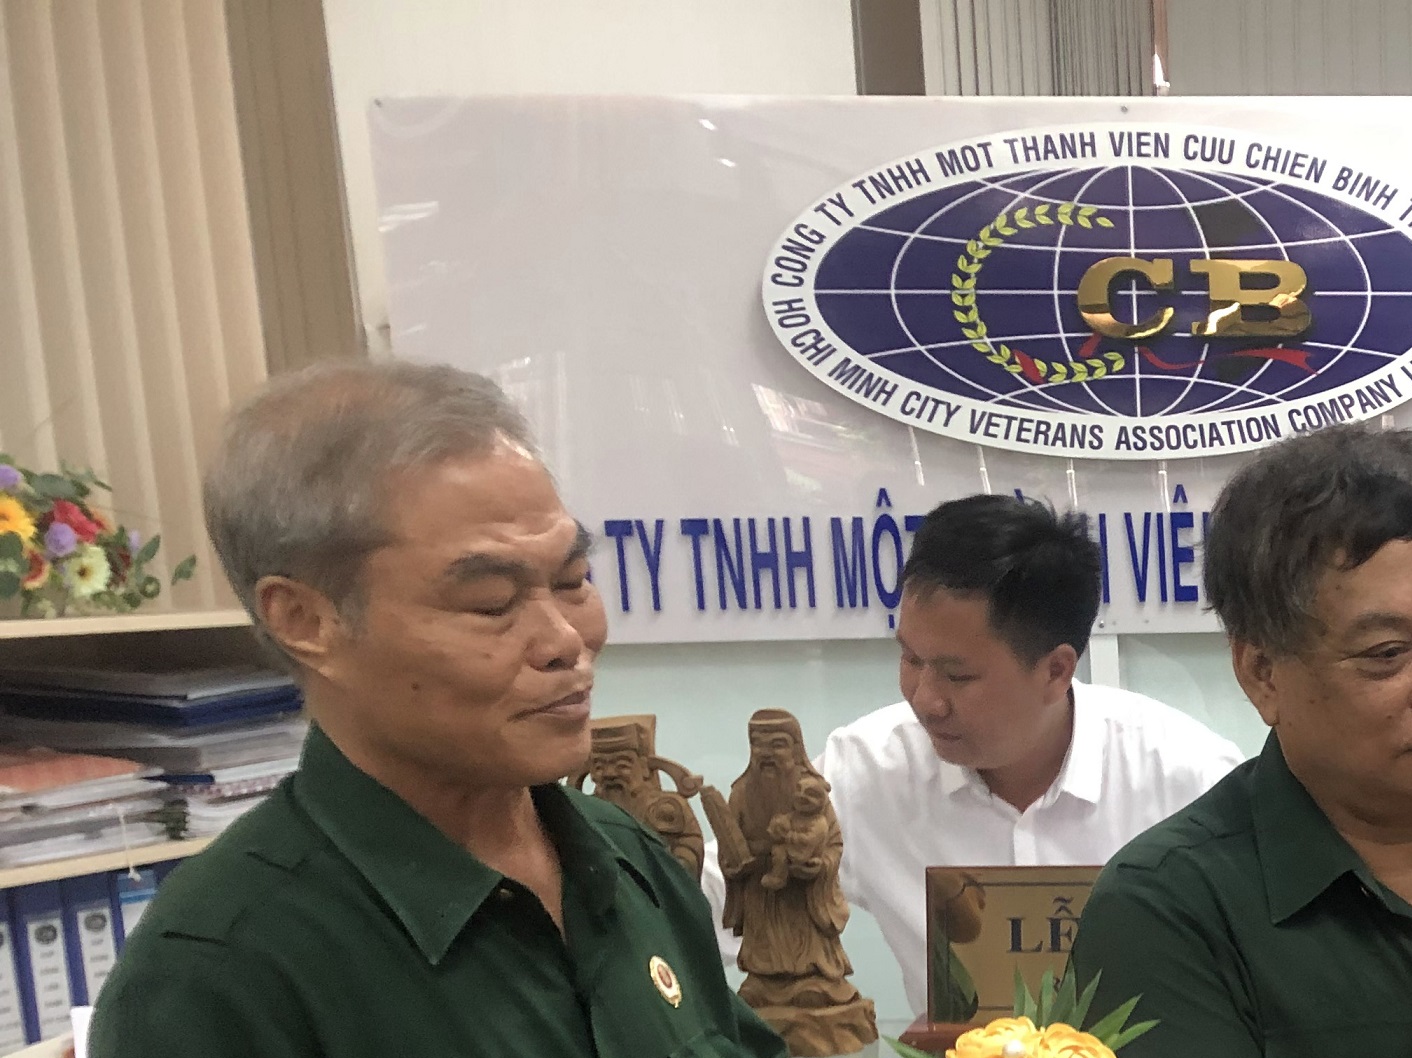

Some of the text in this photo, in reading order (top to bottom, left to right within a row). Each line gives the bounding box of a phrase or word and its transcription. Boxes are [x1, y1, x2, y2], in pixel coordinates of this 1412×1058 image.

[770, 222, 827, 288] CONG
[813, 191, 855, 227] TY
[851, 157, 932, 205] TNHH
[935, 141, 994, 178] MOT
[1003, 131, 1097, 165] THANH
[1108, 131, 1170, 159] VIEN
[1183, 133, 1236, 165] CUU
[1245, 142, 1328, 184] CHIEN
[1331, 165, 1399, 211] BINH
[772, 296, 811, 330] HO
[1077, 257, 1312, 339] CB
[790, 326, 837, 368] CHI
[828, 356, 899, 407] MINH
[1287, 373, 1404, 435] COMPANY
[900, 389, 962, 428] CITY
[968, 407, 1104, 451] VETERANS
[1115, 413, 1282, 451] ASSOCIATION
[604, 518, 665, 613] TY
[679, 516, 817, 612] TNHH
[1123, 483, 1211, 604] VIÊ
